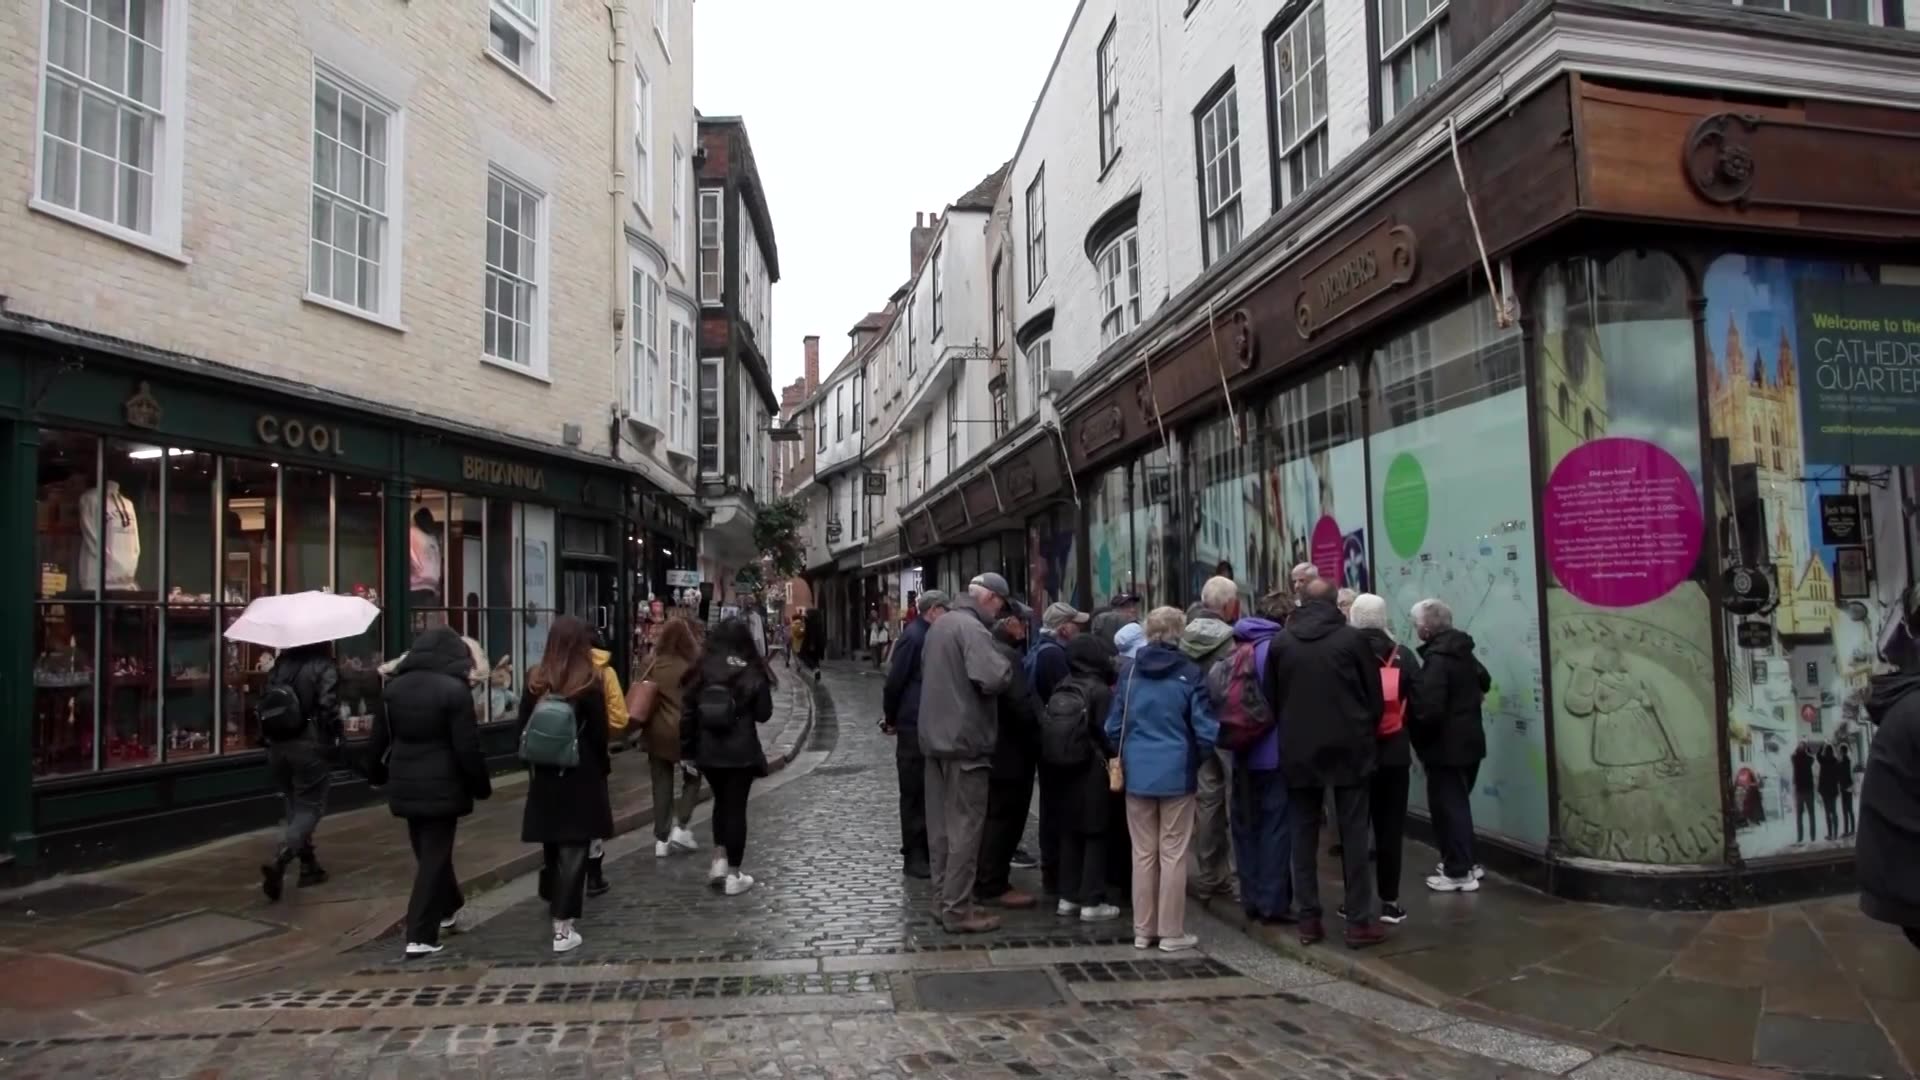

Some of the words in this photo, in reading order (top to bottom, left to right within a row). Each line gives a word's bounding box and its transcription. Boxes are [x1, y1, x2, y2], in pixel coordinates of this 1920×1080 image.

[1813, 313, 1880, 332] Welcome
[1883, 317, 1899, 333] to
[1814, 337, 1920, 366] CATHEDR
[258, 414, 344, 455] COOL
[463, 455, 545, 491] BRITANNIA
